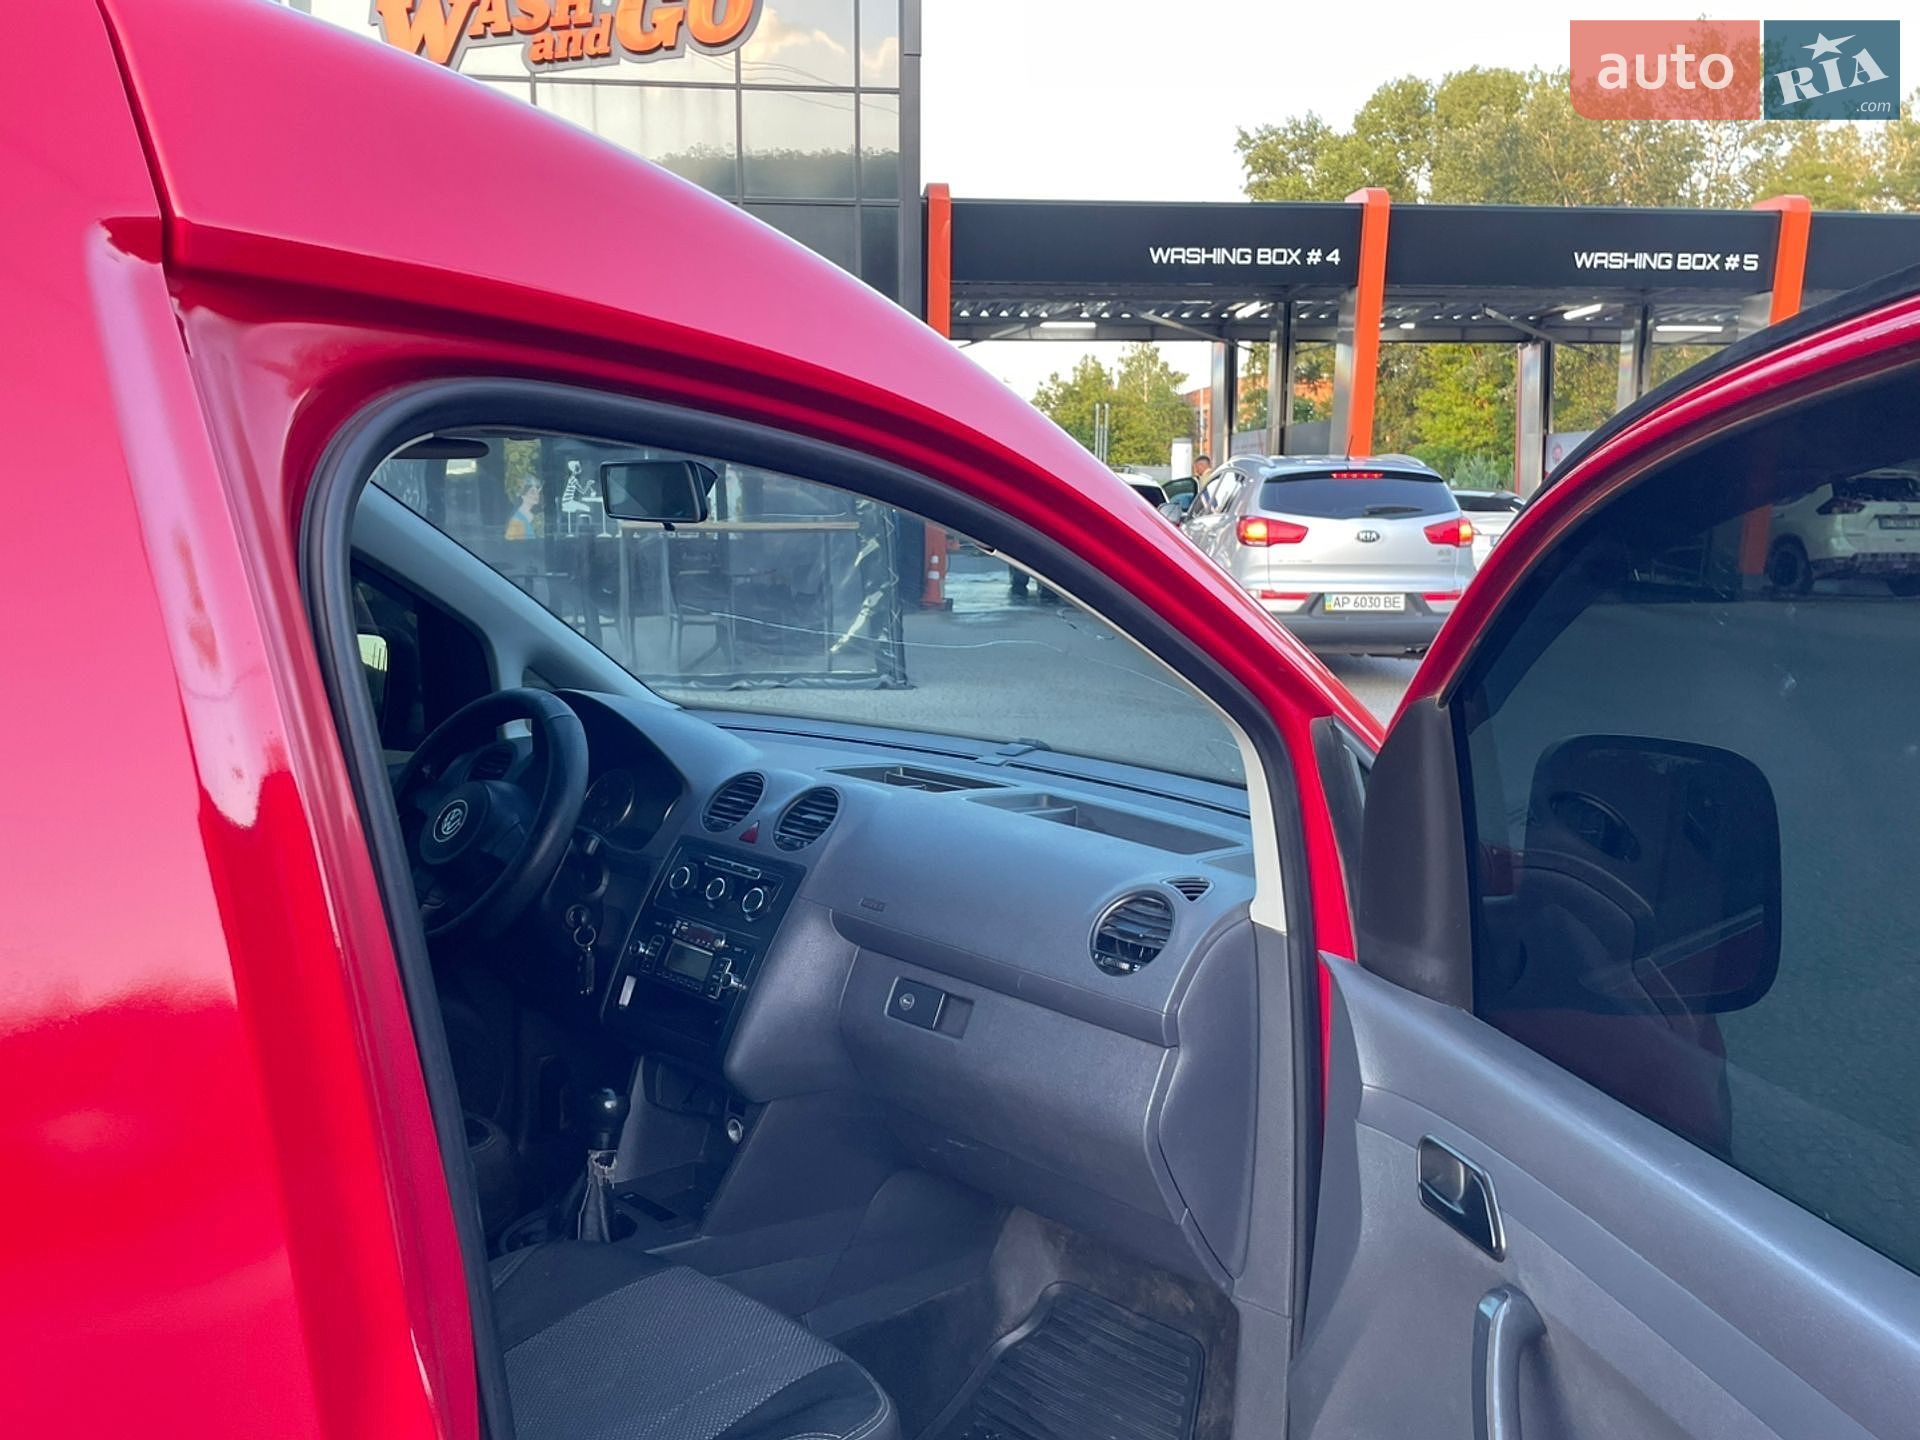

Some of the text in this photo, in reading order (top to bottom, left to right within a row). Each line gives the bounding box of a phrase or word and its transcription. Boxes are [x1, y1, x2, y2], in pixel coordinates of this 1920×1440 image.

[531, 0, 754, 63] and GO
[1150, 247, 1252, 265] WASHING
[1256, 248, 1301, 265] BOX
[1326, 248, 1341, 265] 4
[1574, 252, 1673, 270] WASHING
[1677, 253, 1721, 271] BOX
[1743, 254, 1759, 271] 5
[1358, 531, 1379, 542] KIA
[1353, 596, 1381, 609] 6030
[1383, 596, 1402, 609] BE
